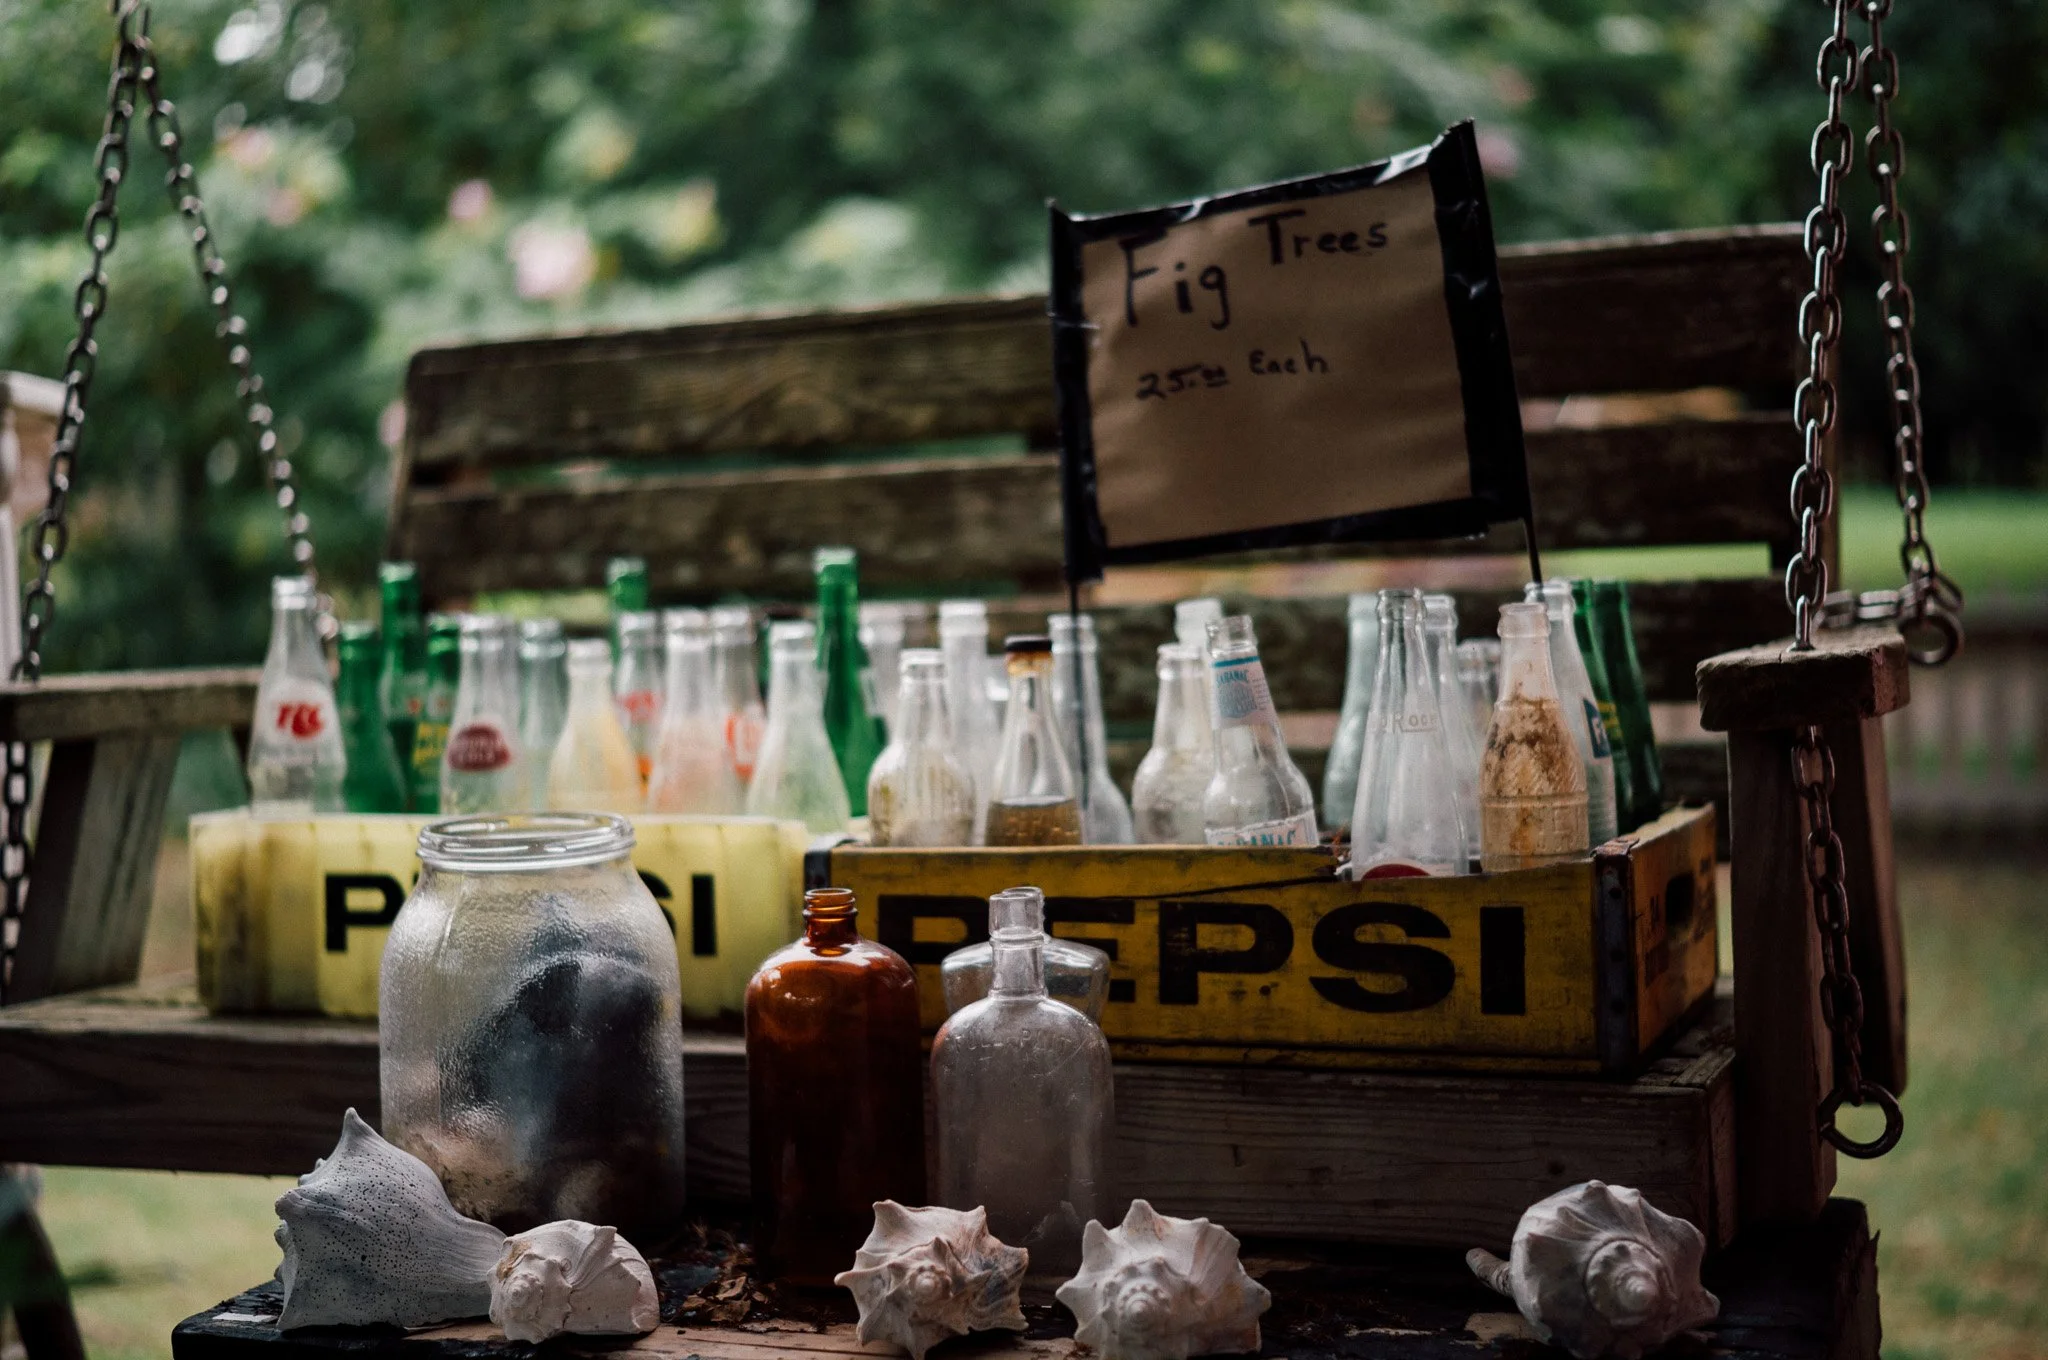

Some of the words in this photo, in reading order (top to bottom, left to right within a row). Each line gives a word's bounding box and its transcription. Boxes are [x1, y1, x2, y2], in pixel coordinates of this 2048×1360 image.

[1119, 232, 1230, 331] Fig
[1248, 210, 1388, 265] Trees
[1249, 336, 1330, 376] Each
